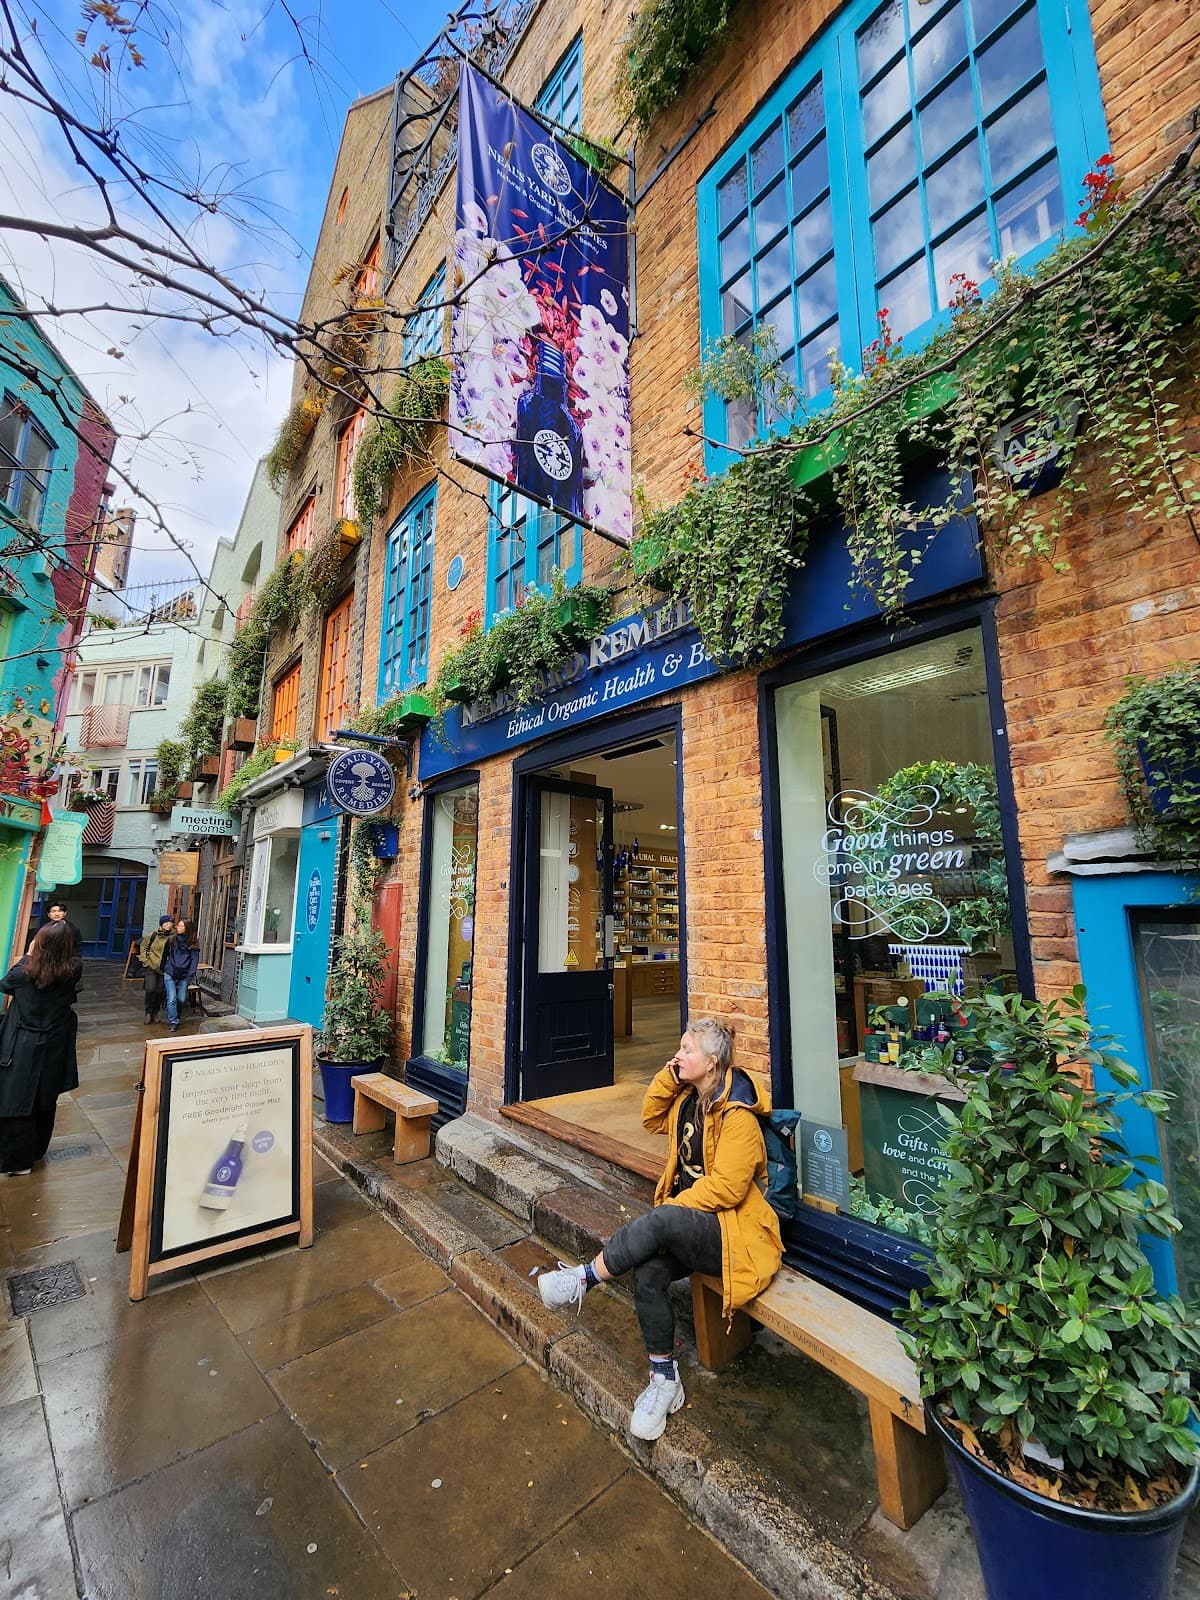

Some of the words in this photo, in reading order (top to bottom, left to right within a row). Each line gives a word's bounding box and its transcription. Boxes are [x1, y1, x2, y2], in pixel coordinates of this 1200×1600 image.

[527, 176, 556, 207] YARD
[506, 707, 546, 739] Ethical
[547, 687, 599, 721] Organic
[601, 662, 656, 702] Health
[661, 653, 683, 677] &
[336, 753, 367, 776] NEAL'S
[369, 756, 390, 782] YARD
[336, 786, 389, 809] REMEDIES
[181, 815, 233, 829] meeting
[187, 824, 226, 834] rooms
[821, 823, 888, 853] Good
[891, 829, 955, 847] things
[817, 863, 864, 876] come
[868, 860, 885, 873] in
[886, 849, 966, 879] green
[844, 881, 933, 900] packages
[182, 1111, 203, 1121] FREE
[204, 1103, 243, 1117] Goodnight
[266, 1097, 281, 1105] Mist
[882, 1142, 907, 1160] love
[908, 1153, 926, 1166] and
[897, 1133, 929, 1152] Gifts
[901, 1166, 919, 1178] and
[919, 1171, 936, 1184] the
